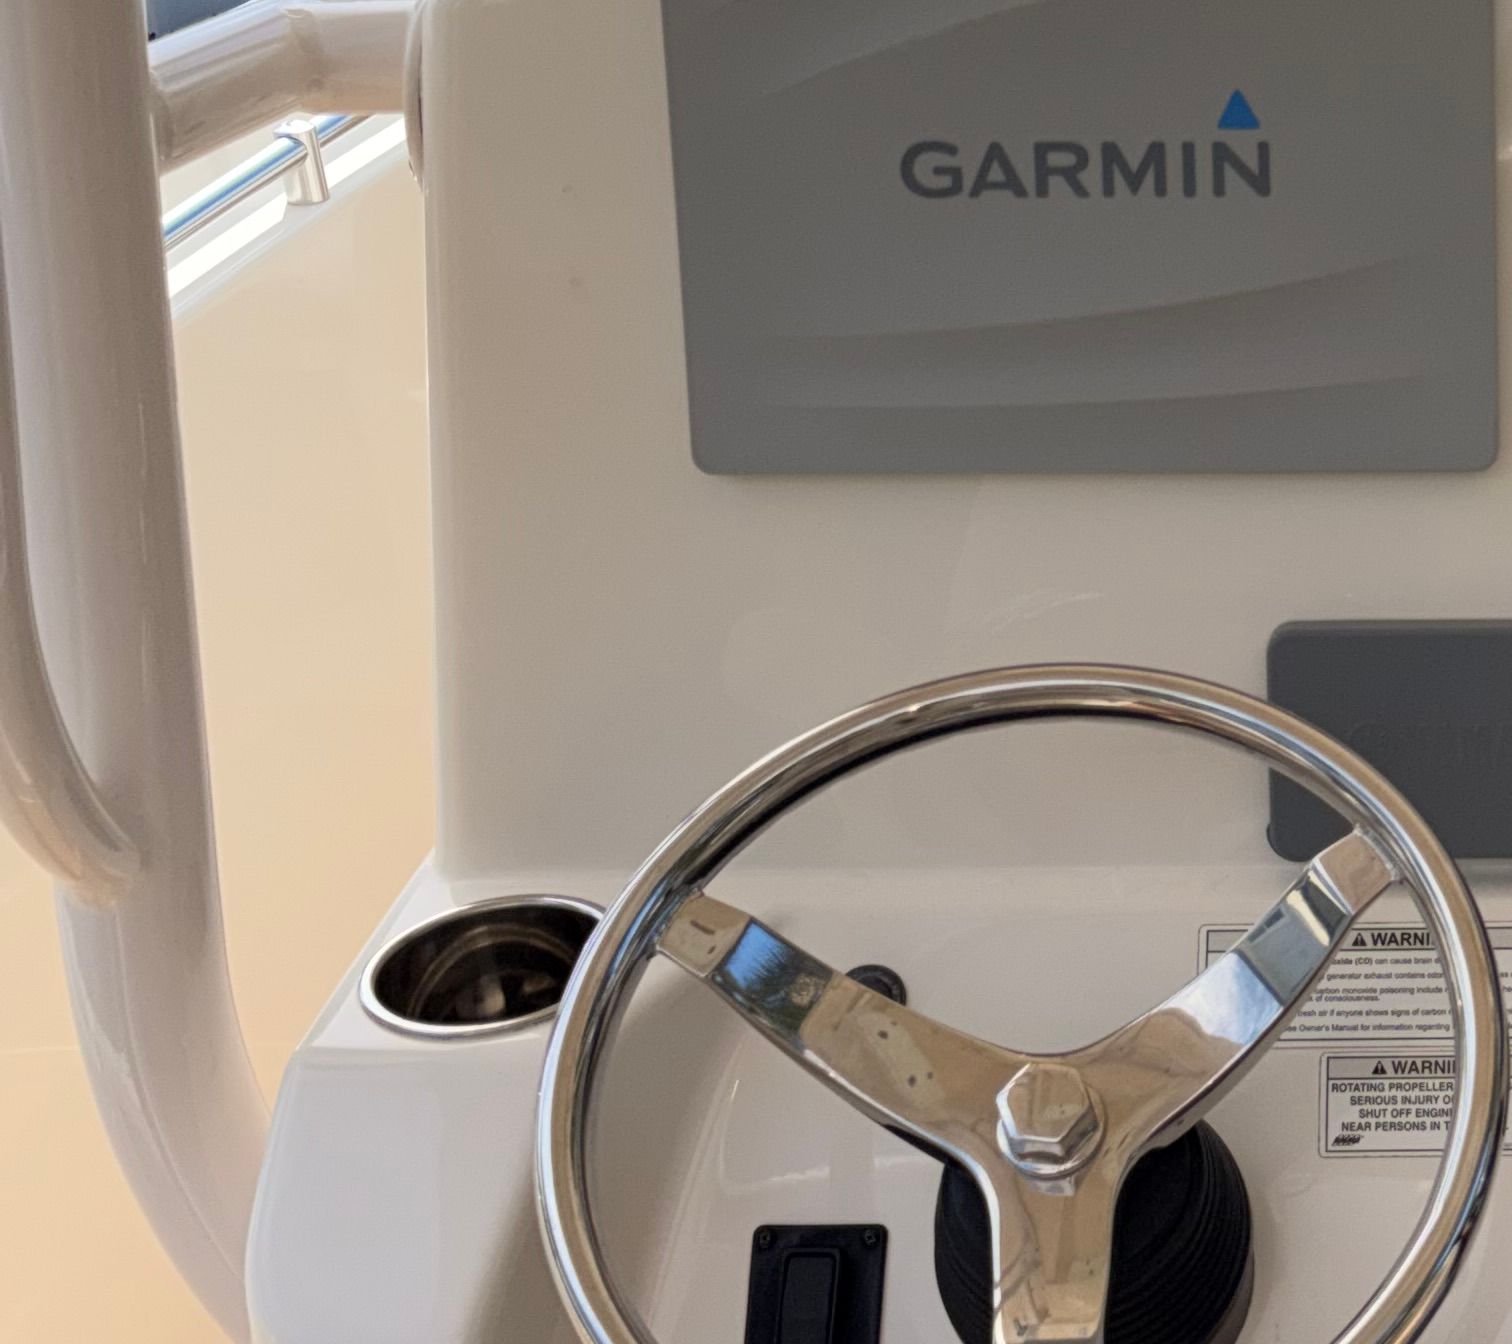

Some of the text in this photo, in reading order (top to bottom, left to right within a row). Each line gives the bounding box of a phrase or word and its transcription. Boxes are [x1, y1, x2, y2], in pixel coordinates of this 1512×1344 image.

[900, 140, 1272, 199] GARMIN
[1371, 932, 1430, 946] WARNI
[1391, 1060, 1456, 1074] WARNI
[1331, 1081, 1454, 1092] ROTATING PROPELLER
[1350, 1095, 1398, 1105] SERIOUS
[1401, 1094, 1440, 1104] INJURY
[1358, 1108, 1388, 1118] SHUT
[1392, 1108, 1412, 1118] OFF
[1341, 1121, 1372, 1131] NEAR
[1375, 1121, 1427, 1131] PERSONS
[1430, 1121, 1440, 1130] IN
